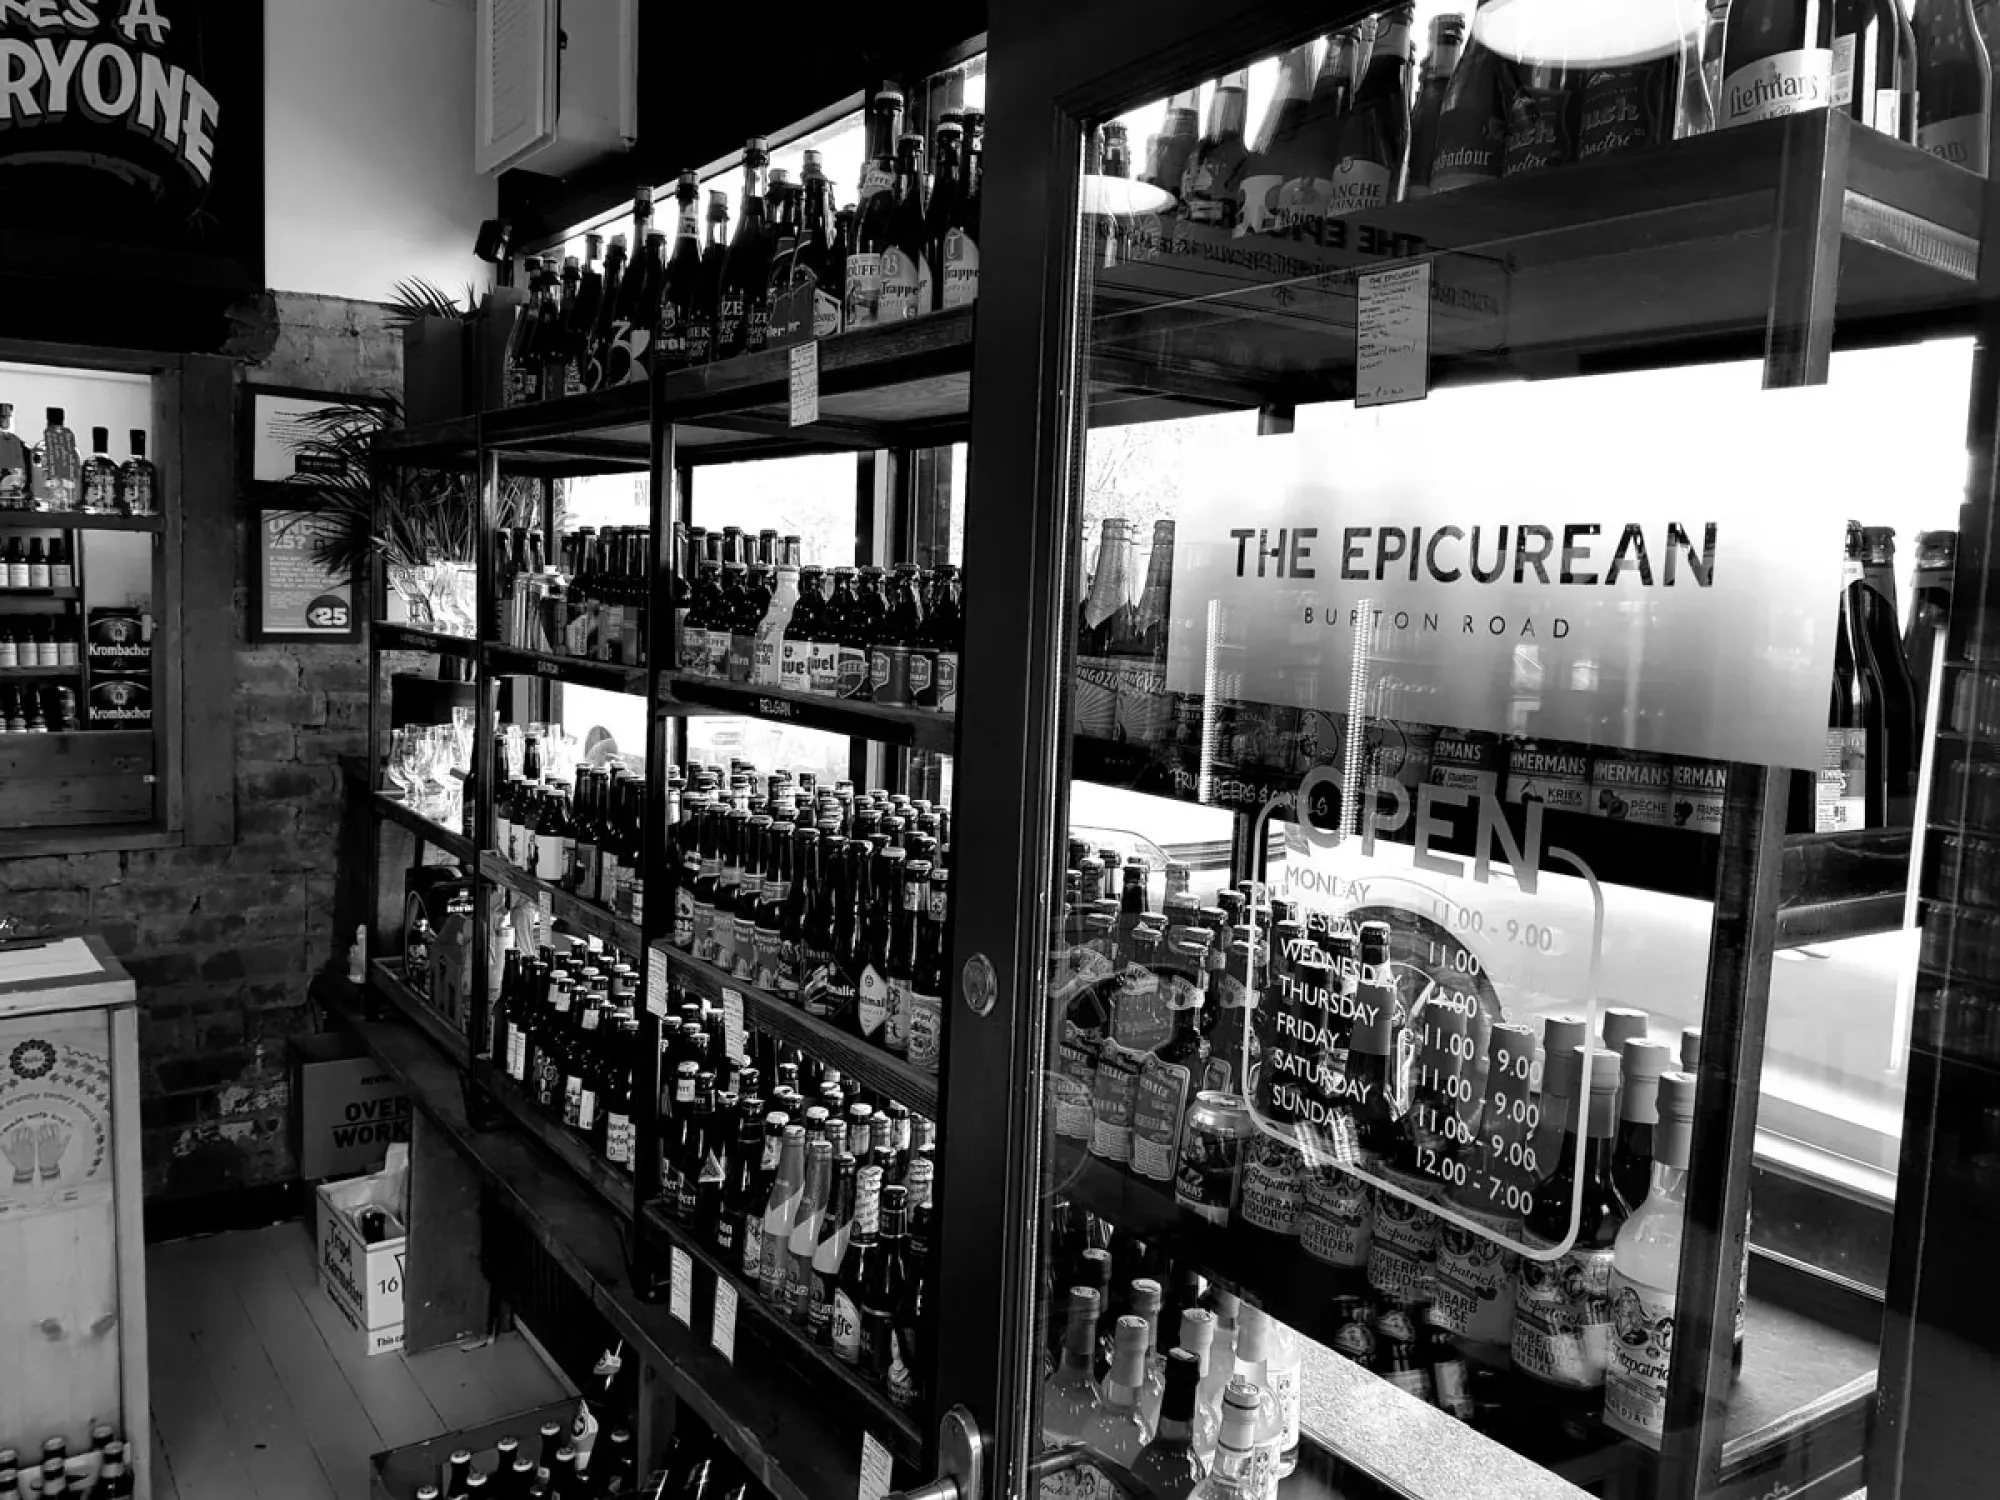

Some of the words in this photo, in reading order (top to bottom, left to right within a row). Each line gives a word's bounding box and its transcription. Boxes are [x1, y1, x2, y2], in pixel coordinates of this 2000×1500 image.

[117, 0, 171, 43] A
[1230, 526, 1318, 579] THE
[1341, 521, 1718, 588] EPICUREAN
[90, 642, 152, 657] Krombacher
[1303, 605, 1439, 634] BURTON
[1462, 614, 1571, 639] ROAD
[90, 706, 152, 720] Krombacher
[1296, 764, 1545, 895] OPEN
[1284, 864, 1371, 906] MONDAY
[1506, 918, 1553, 951] 9.00
[1280, 936, 1403, 993] WEDNESDAY
[1428, 941, 1481, 976] 11.00
[1278, 974, 1380, 1028] THURSDAY
[1423, 1022, 1475, 1054] 11.00
[1497, 1048, 1542, 1085] 9.00
[1275, 1013, 1340, 1053] FRIDAY
[1421, 1063, 1472, 1102] 11.00
[1494, 1091, 1540, 1128] 9.00
[345, 1096, 412, 1122] OVER
[1272, 1082, 1349, 1128] SUNDAY
[1415, 1145, 1467, 1186] 12.00
[1273, 1048, 1373, 1107] SATURDAY
[1419, 1104, 1470, 1145] 11.00
[1491, 1134, 1536, 1173] 9.00
